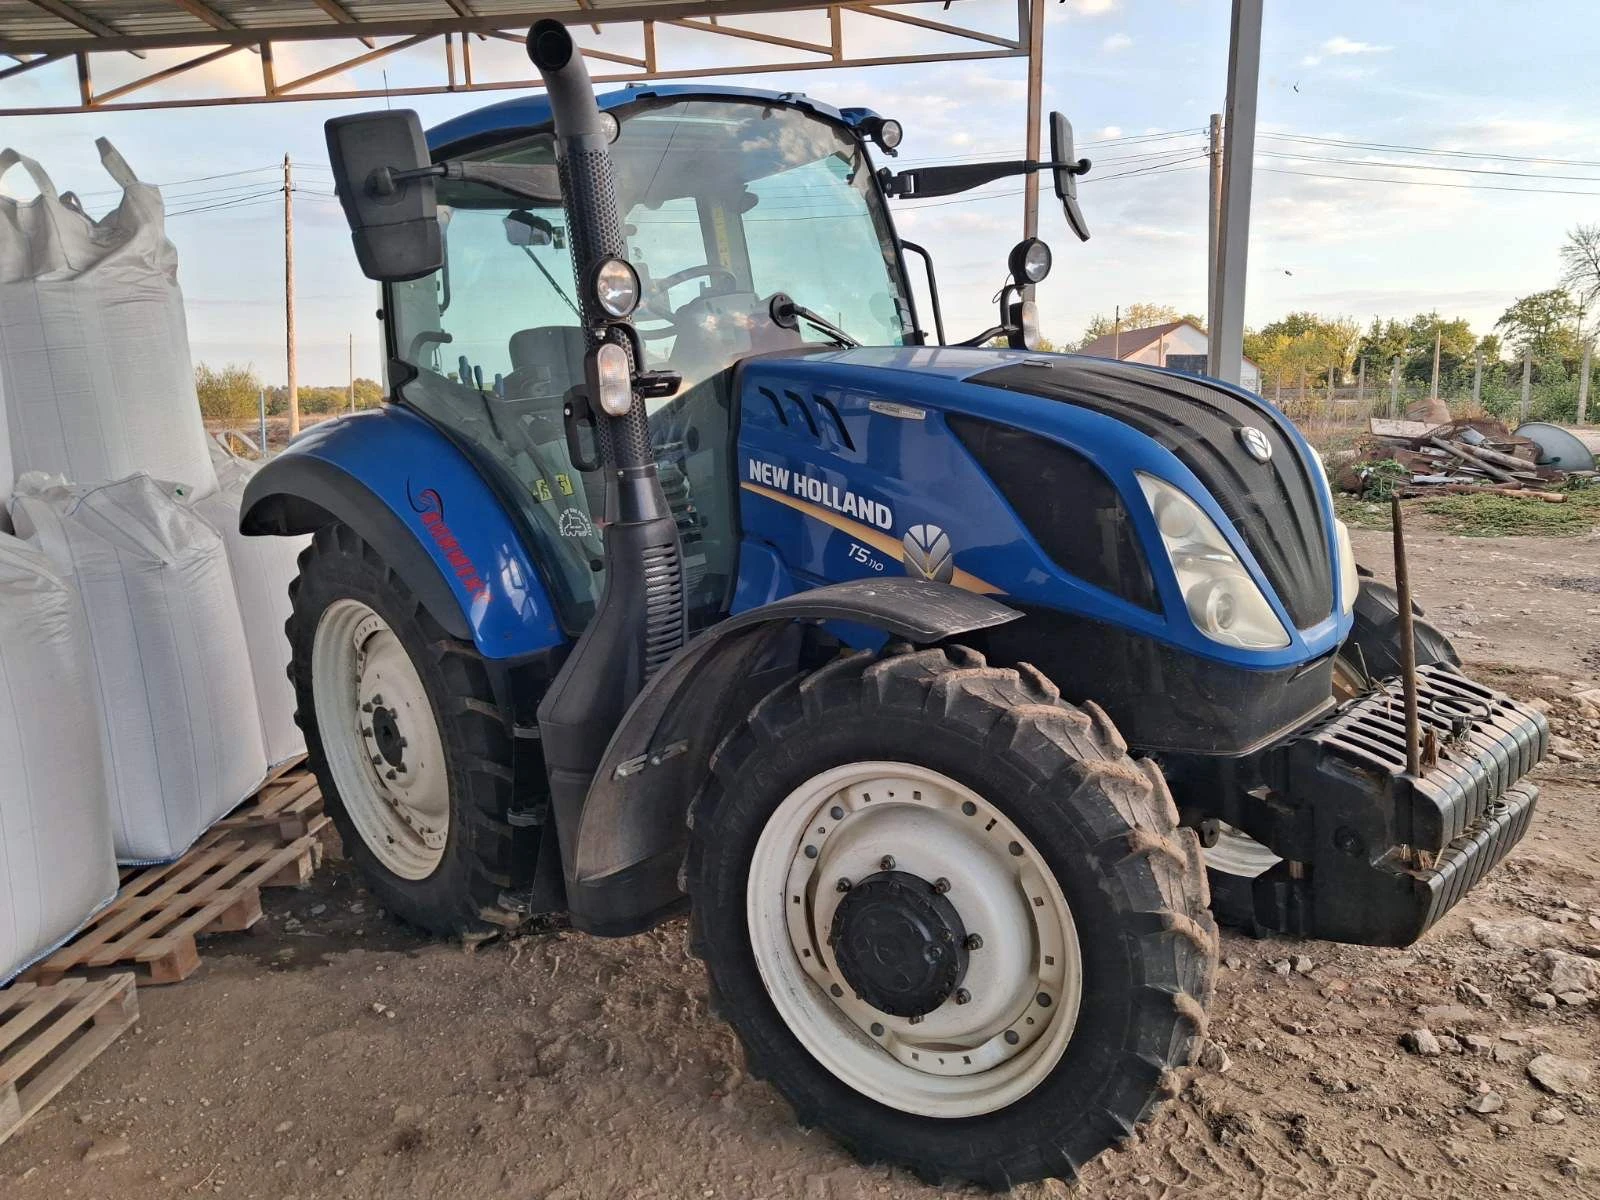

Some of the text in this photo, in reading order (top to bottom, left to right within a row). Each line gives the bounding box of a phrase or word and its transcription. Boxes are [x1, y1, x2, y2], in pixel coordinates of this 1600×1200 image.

[749, 458, 893, 530] NEW HOLLAND
[848, 543, 884, 571] T5.110
